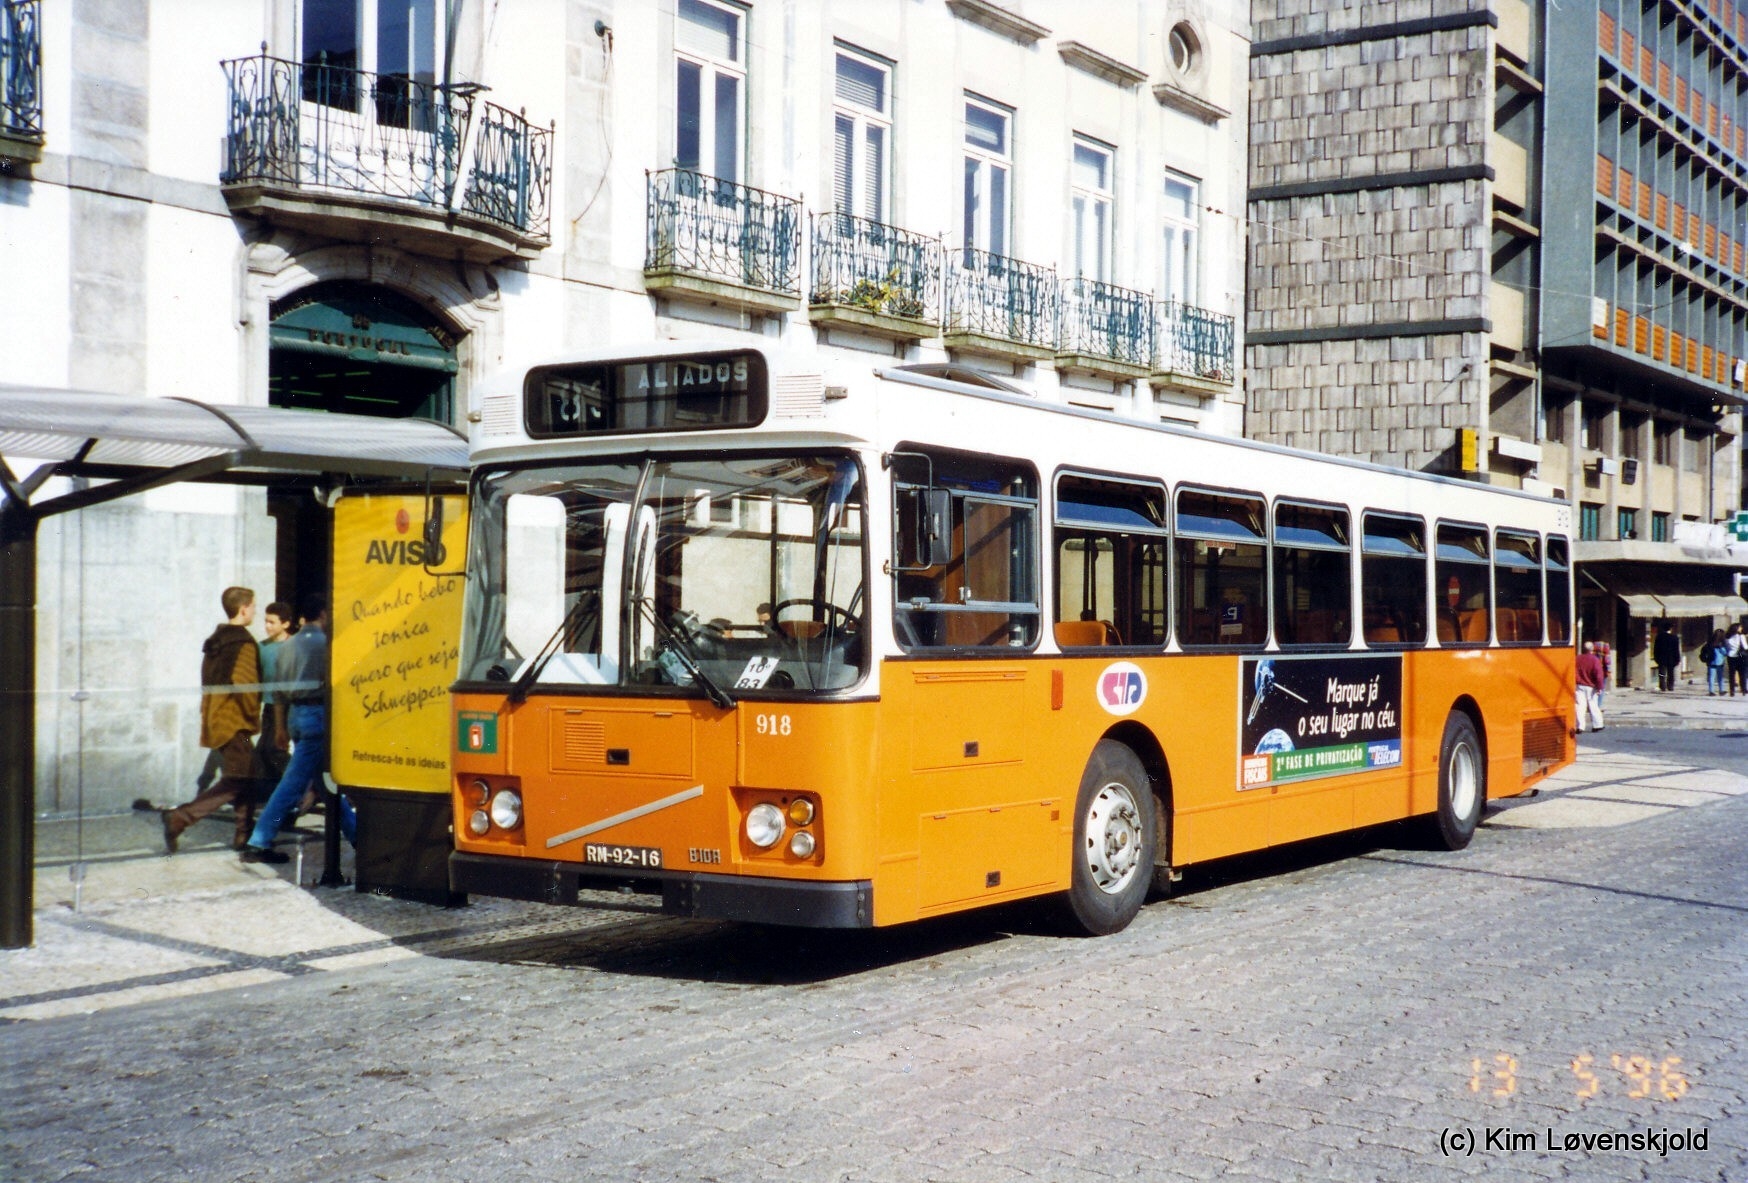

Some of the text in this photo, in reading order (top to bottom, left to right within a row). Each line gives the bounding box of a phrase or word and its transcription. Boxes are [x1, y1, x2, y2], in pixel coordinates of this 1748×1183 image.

[637, 362, 748, 389] ALIADOS
[352, 588, 413, 621] Quando
[396, 657, 423, 681] que
[1326, 674, 1380, 709] Marque já
[756, 713, 792, 736] 918
[1298, 702, 1396, 739] o seu lugar no céu.
[1286, 754, 1303, 771] FASE
[1304, 752, 1315, 768] DE
[1315, 745, 1364, 767] PRIVATIZAÇÃO
[586, 845, 660, 867] RM-92-16
